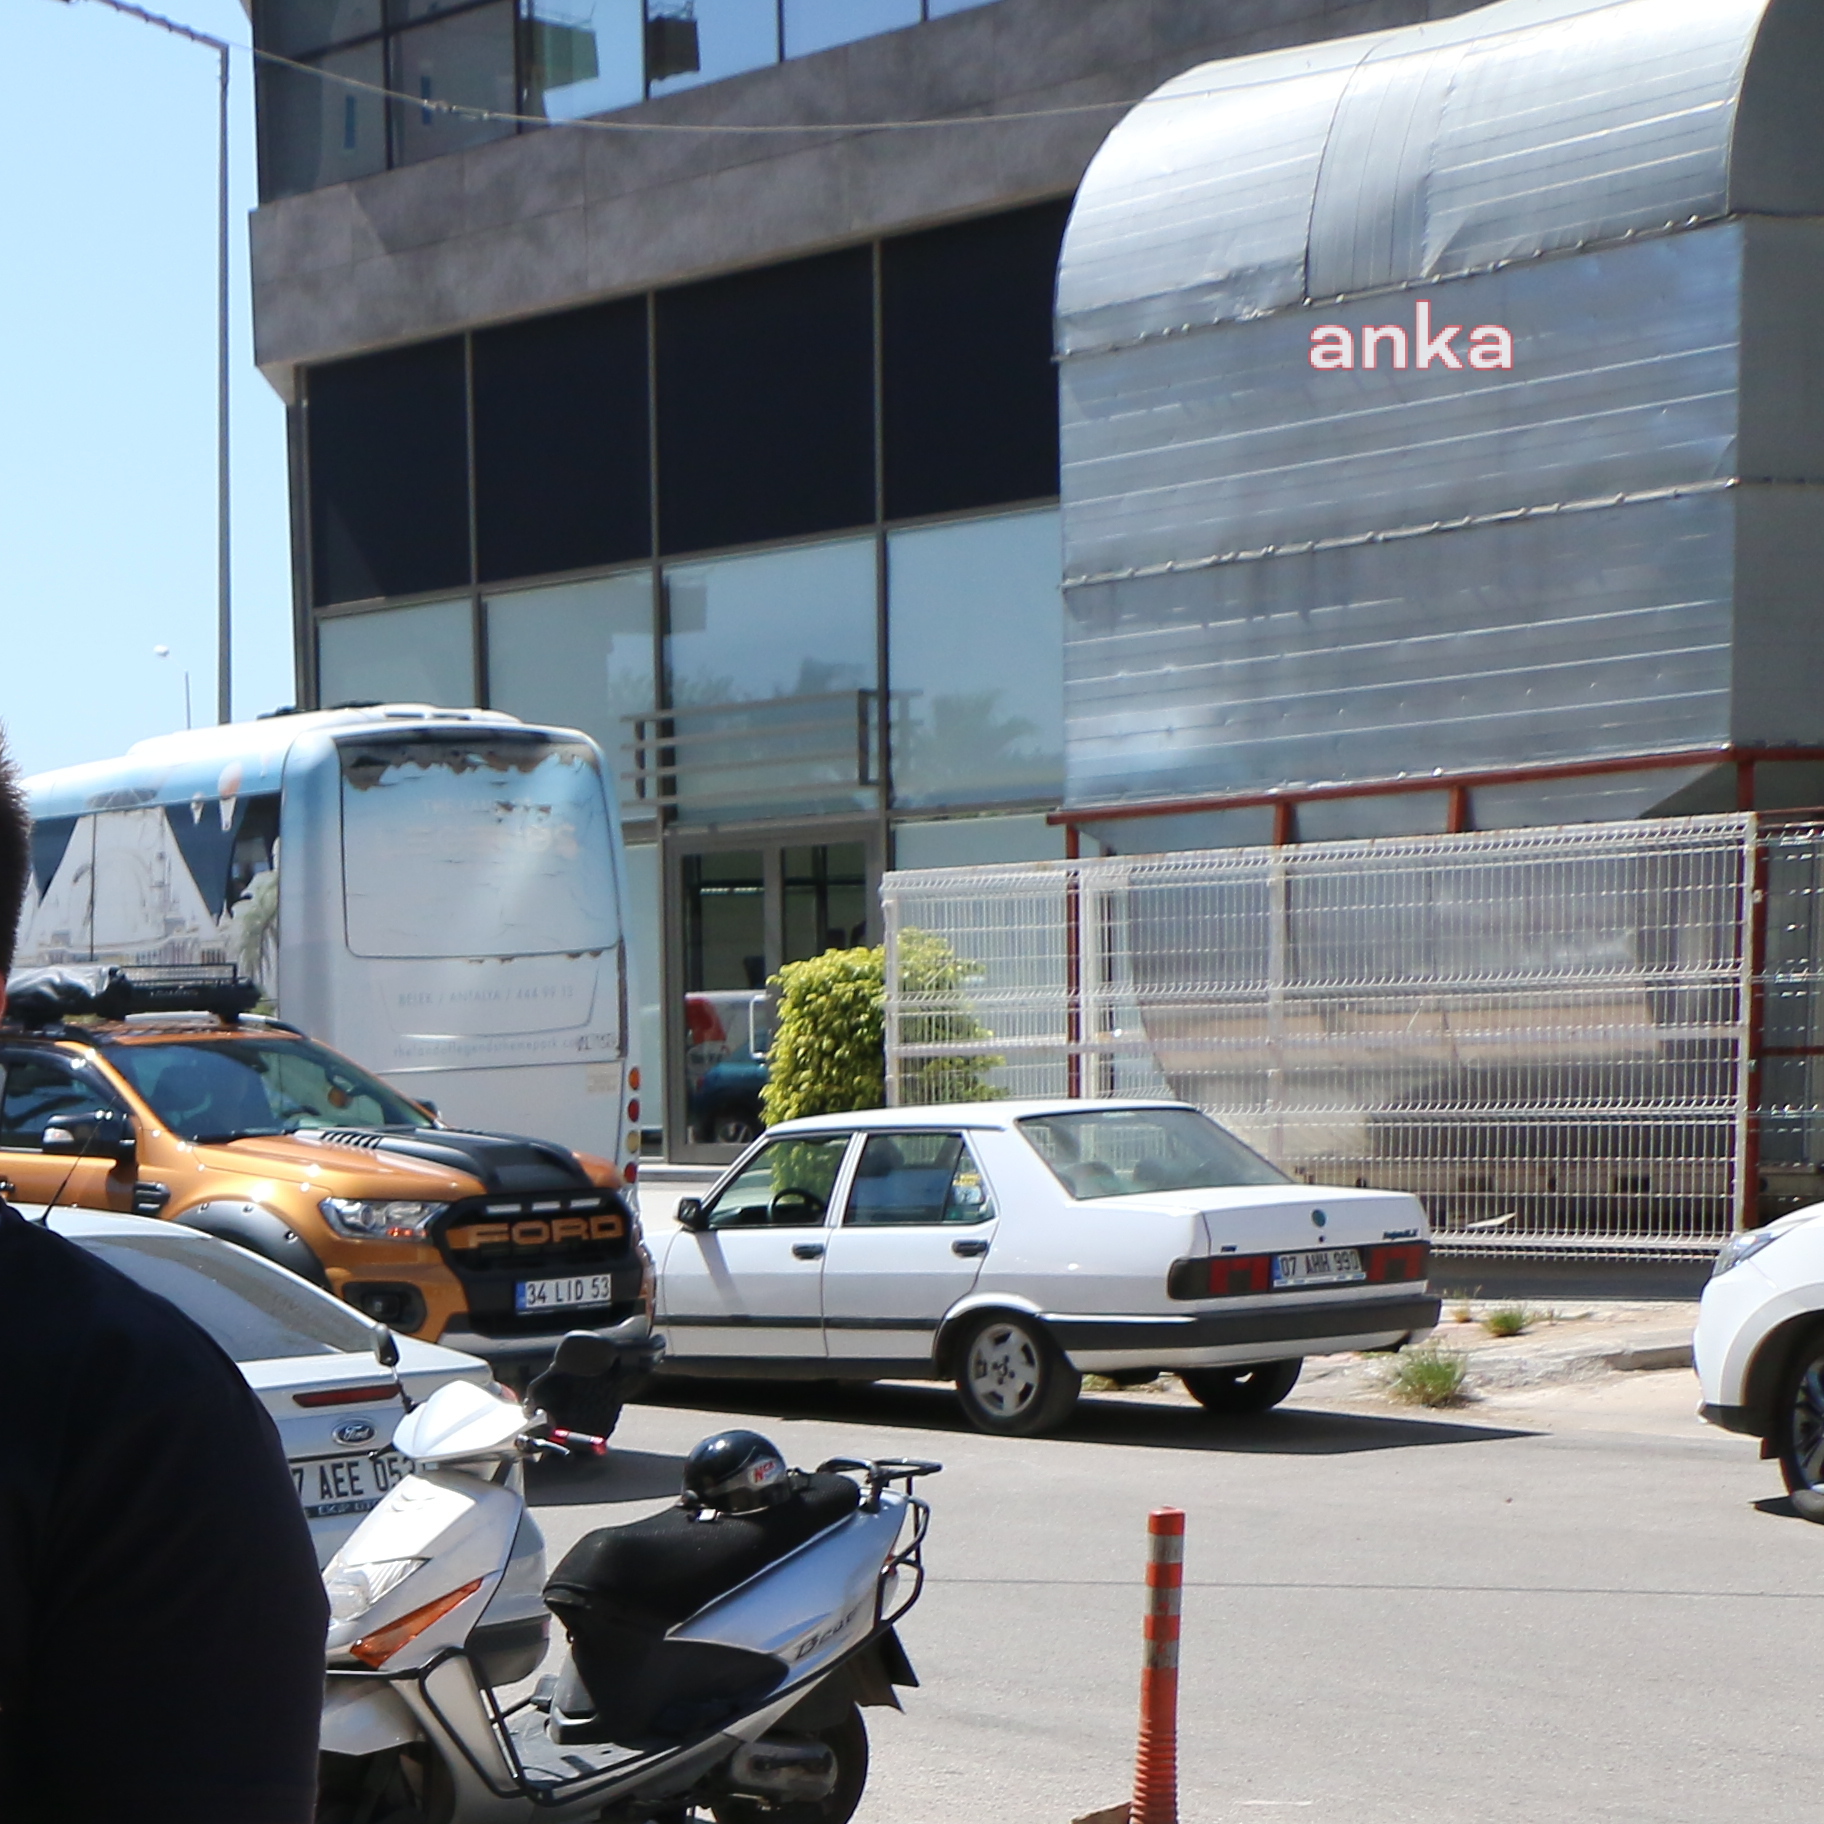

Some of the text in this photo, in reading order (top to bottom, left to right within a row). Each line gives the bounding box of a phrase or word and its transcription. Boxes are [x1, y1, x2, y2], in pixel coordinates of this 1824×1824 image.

[468, 1214, 625, 1248] FORD
[1280, 1255, 1296, 1277] 07
[1306, 1253, 1330, 1274] AHH
[528, 1276, 609, 1305] 34 LID 53
[320, 1461, 363, 1499] AEE
